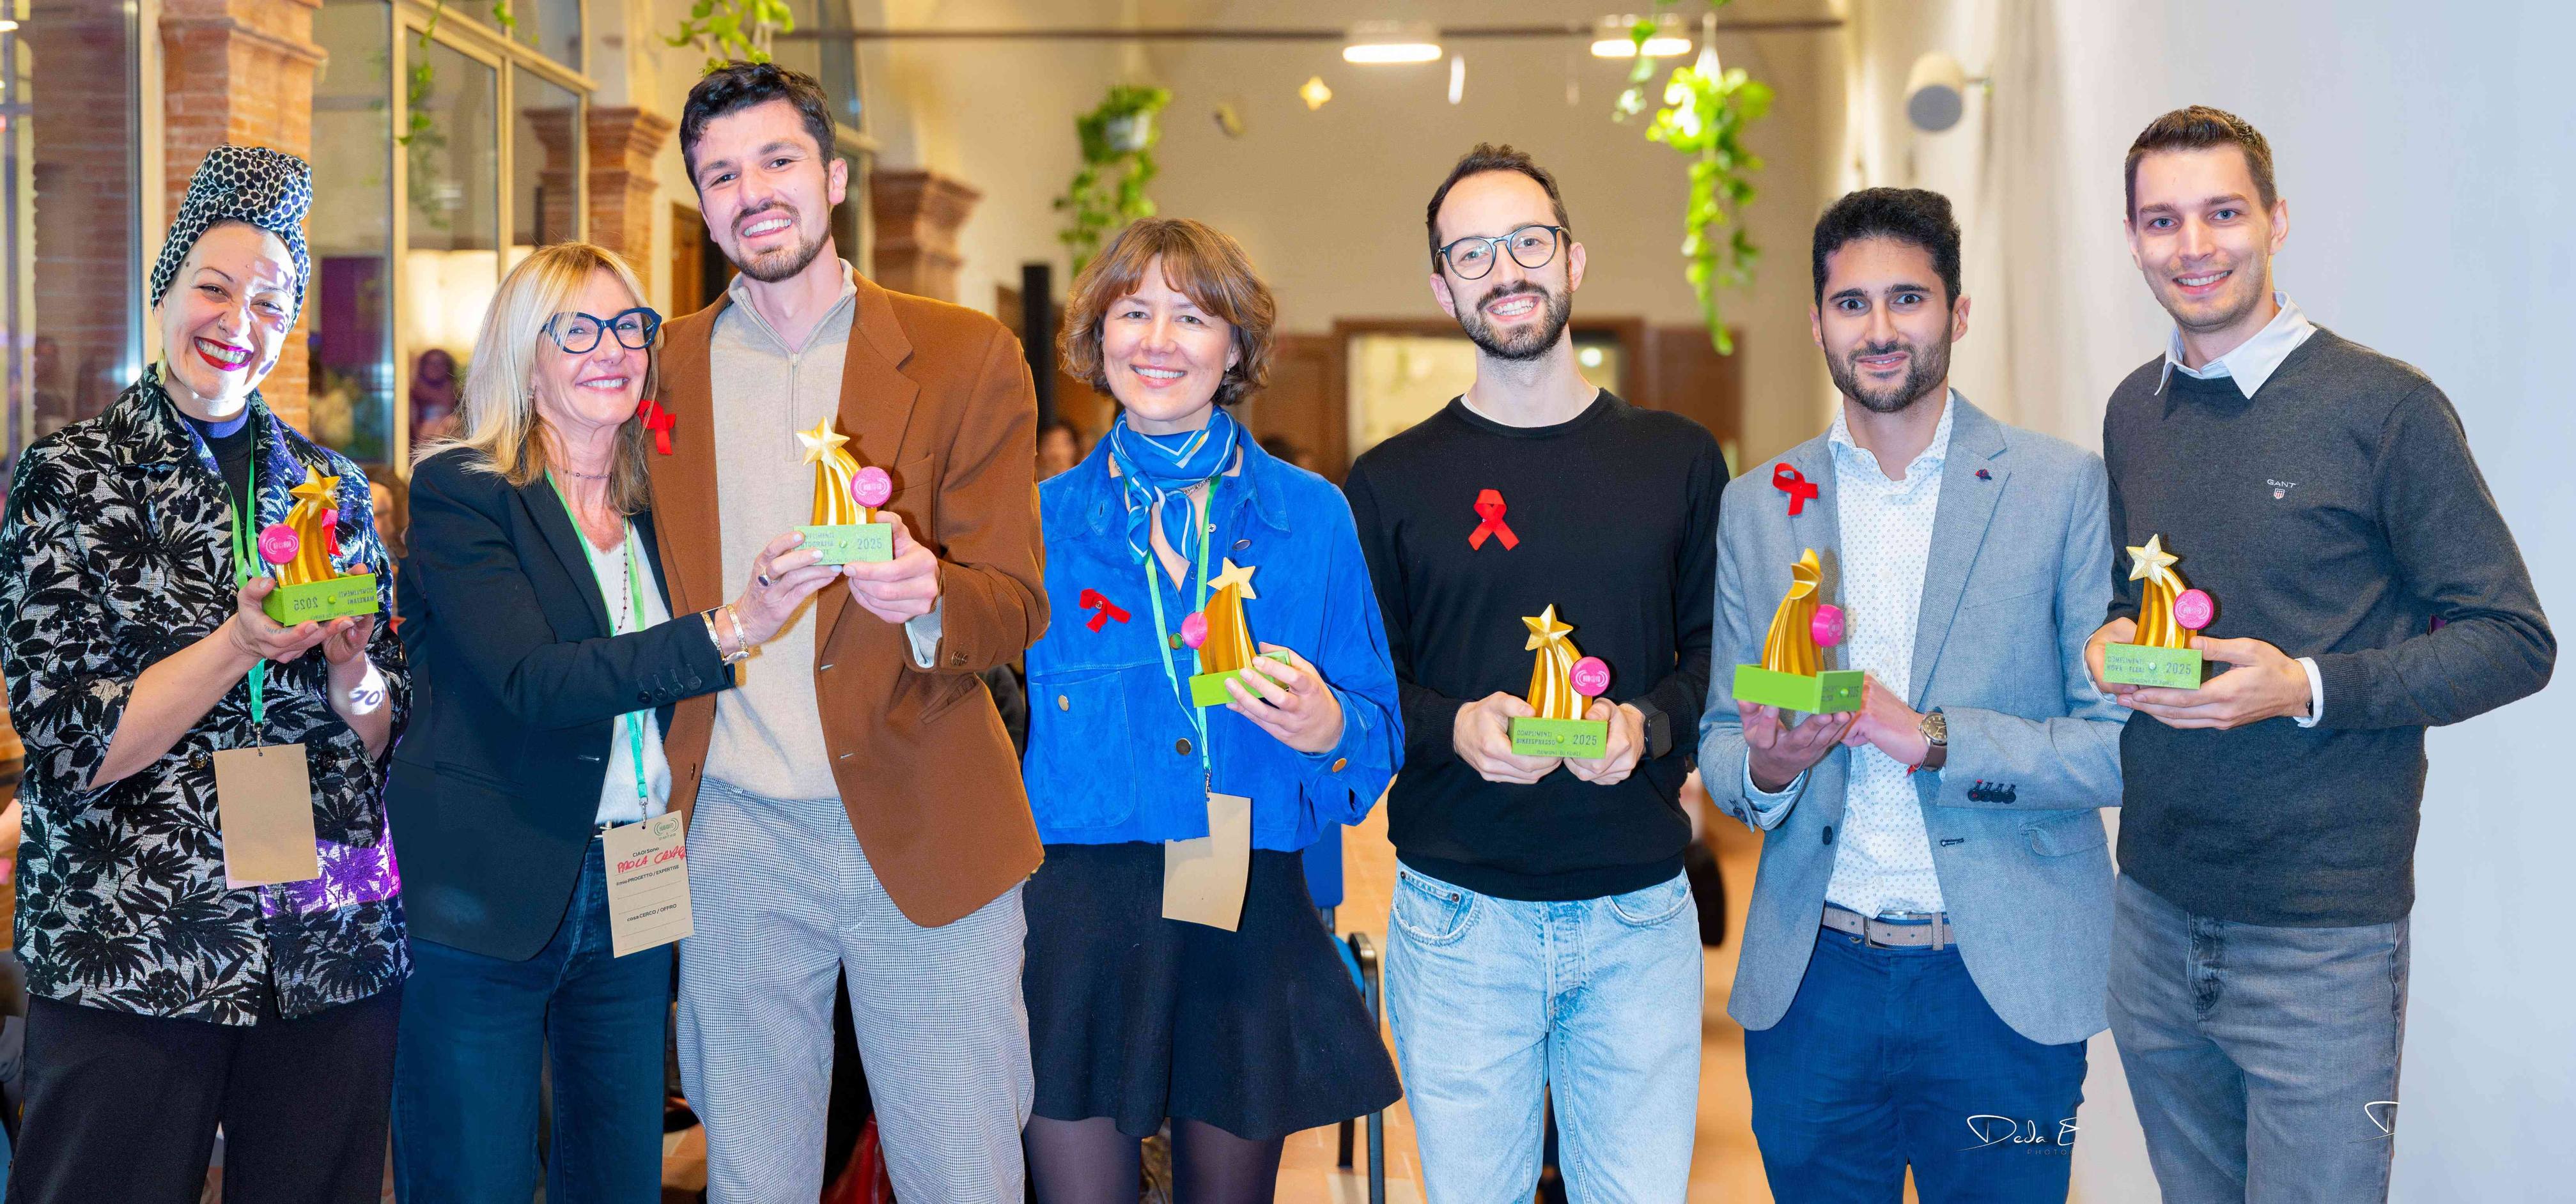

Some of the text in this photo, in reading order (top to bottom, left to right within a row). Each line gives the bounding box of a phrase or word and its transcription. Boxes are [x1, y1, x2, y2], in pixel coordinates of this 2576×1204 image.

[2267, 479, 2296, 488] GANT
[857, 537, 882, 550] 2025
[2166, 662, 2191, 675] 2025
[1572, 734, 1597, 746] 2025
[617, 855, 649, 874] PAOLA
[628, 872, 653, 883] PROGETTO
[656, 864, 679, 875] EXPERTISE
[639, 909, 656, 918] CERCO
[660, 904, 677, 912] OFFRO
